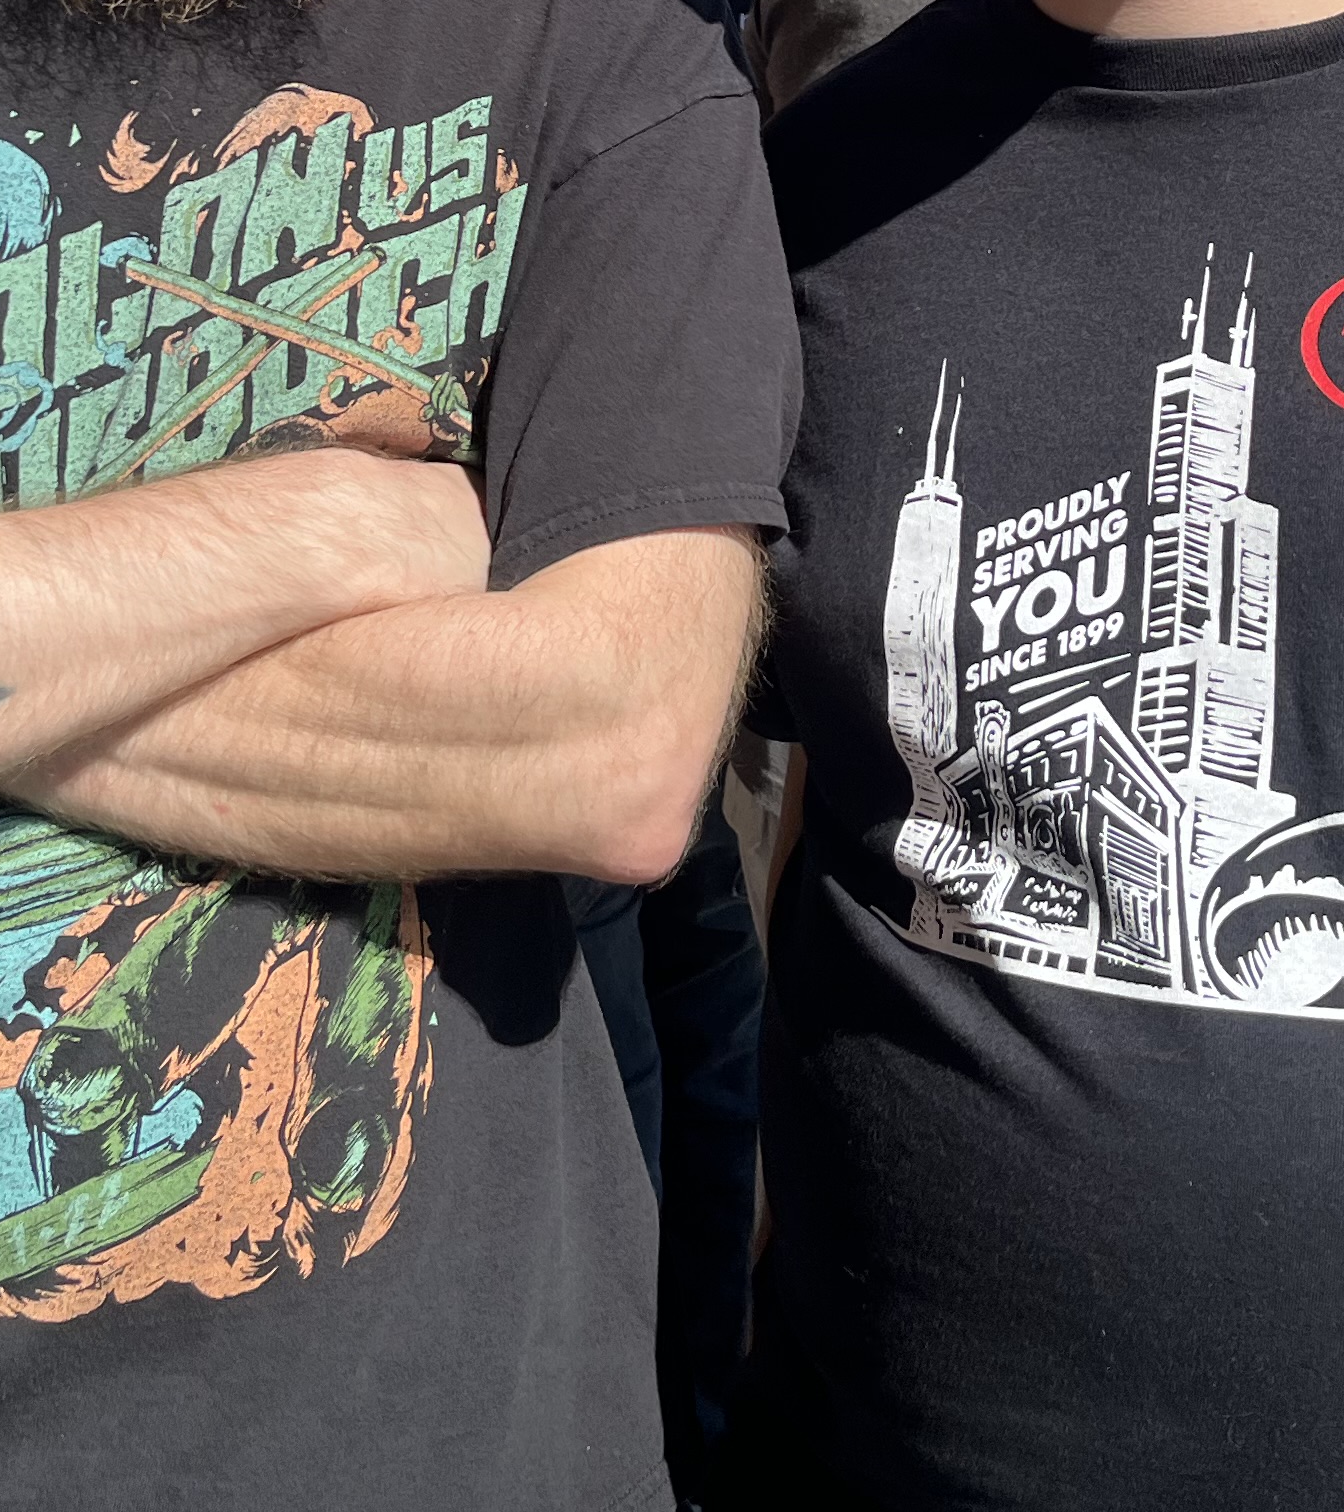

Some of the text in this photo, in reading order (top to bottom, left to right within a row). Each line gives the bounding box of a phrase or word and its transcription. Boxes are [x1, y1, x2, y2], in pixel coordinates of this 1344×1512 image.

[971, 509, 1129, 593] SERVING
[976, 471, 1131, 559] PROUDLY
[970, 543, 1127, 653] YOU
[964, 611, 1125, 692] SINCE 1899
